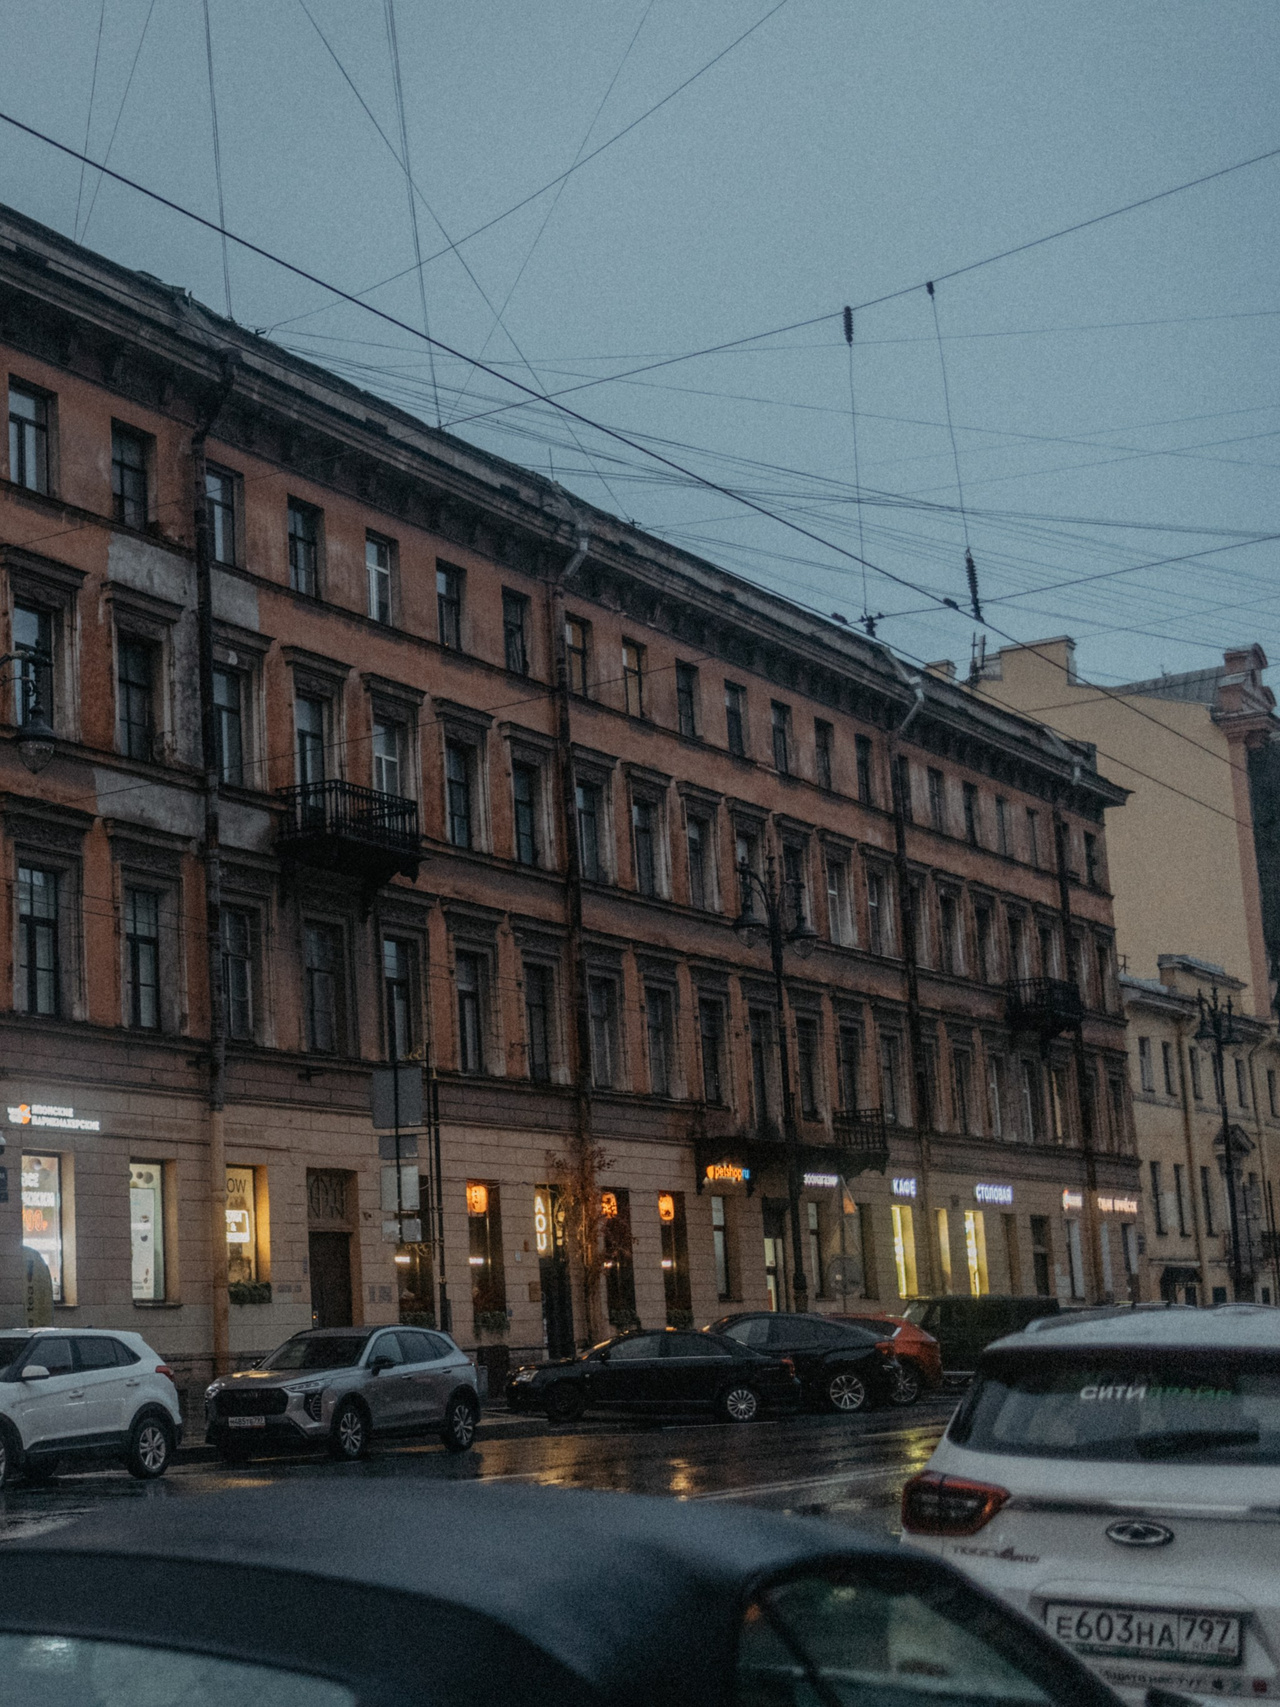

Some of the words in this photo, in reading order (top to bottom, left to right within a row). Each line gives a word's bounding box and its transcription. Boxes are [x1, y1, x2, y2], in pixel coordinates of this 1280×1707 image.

[227, 1178, 246, 1193] OW
[892, 1178, 917, 1199] КАФЕ
[975, 1184, 1013, 1205] СТОЛОВАЯ
